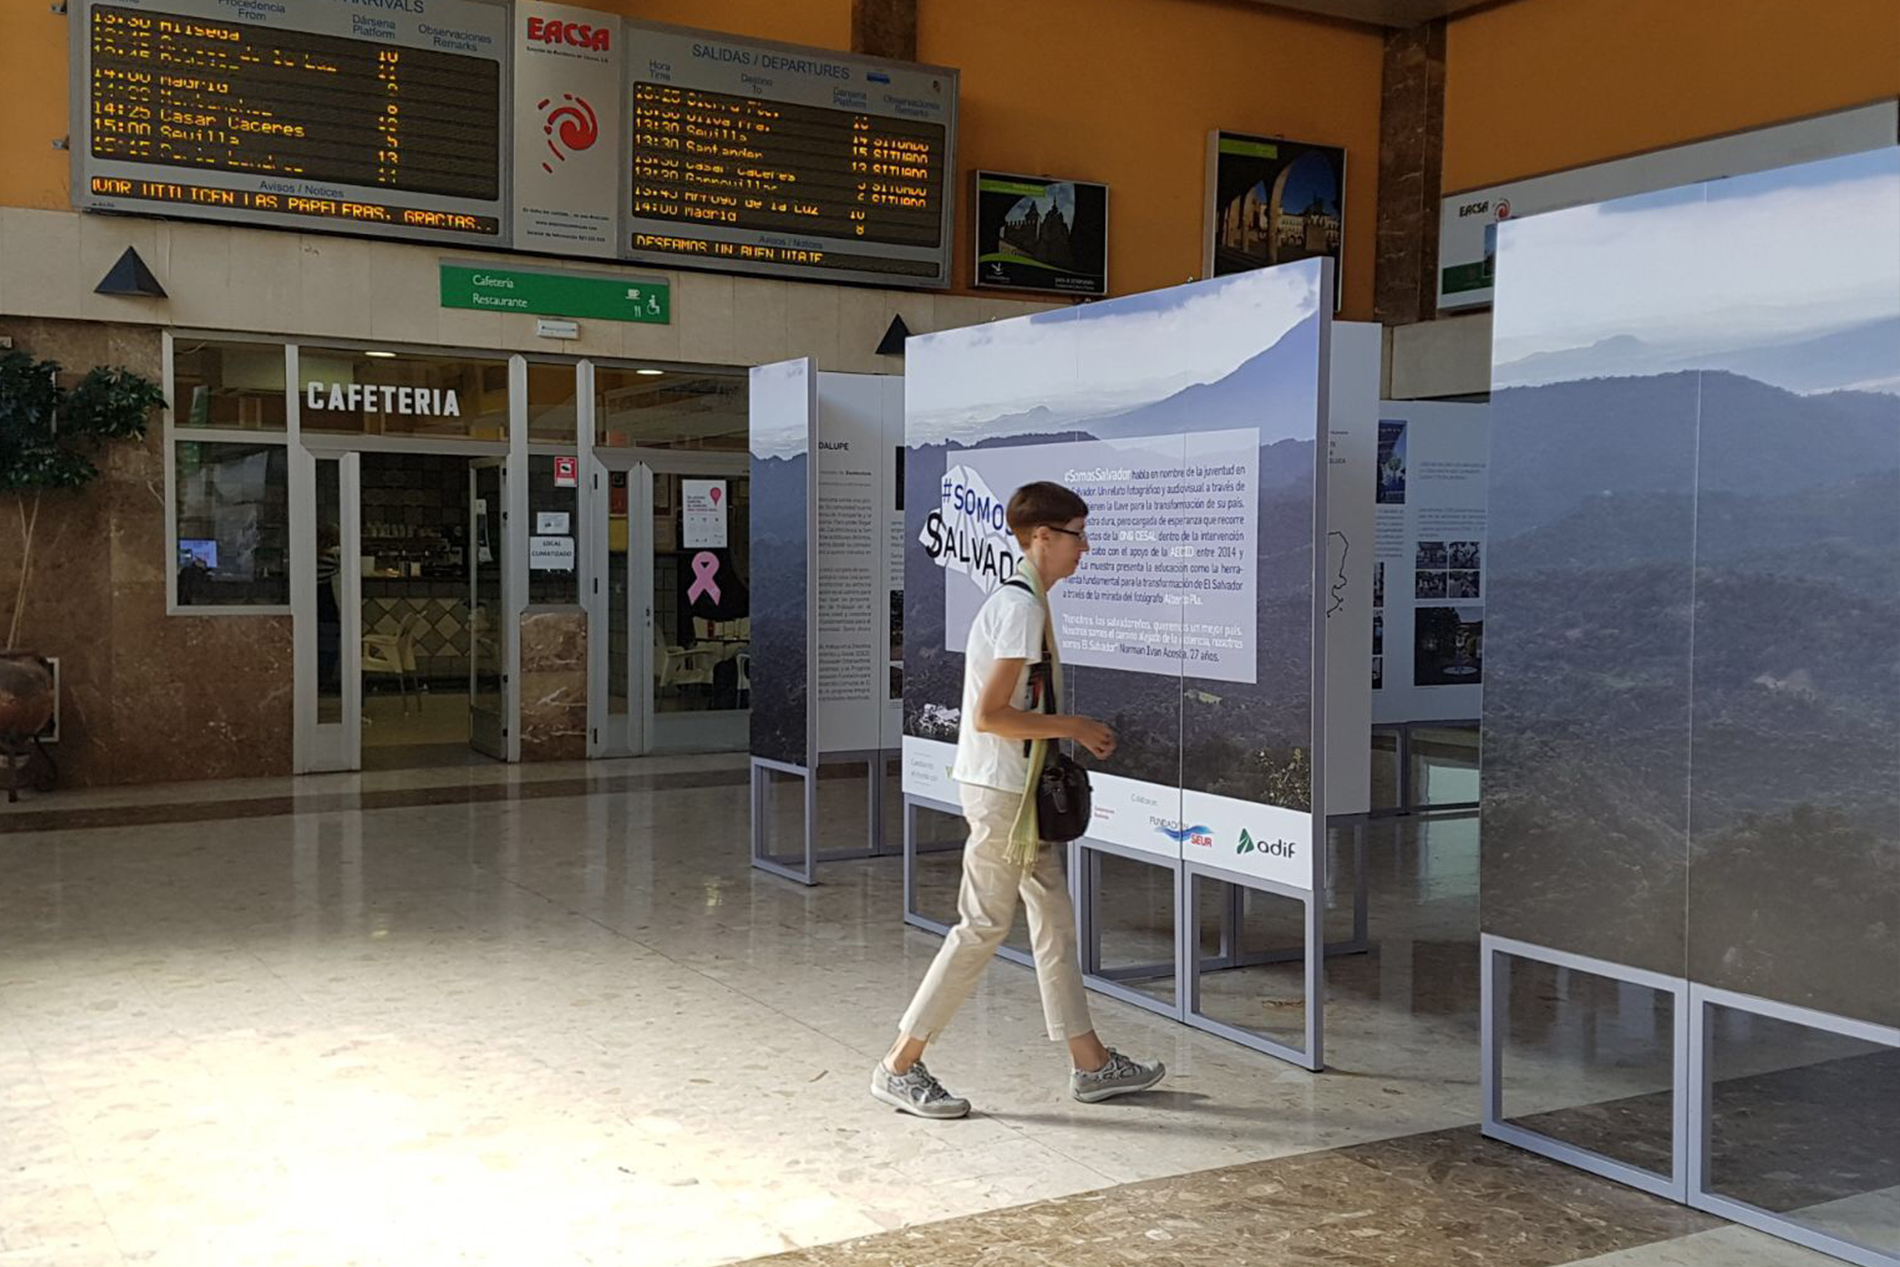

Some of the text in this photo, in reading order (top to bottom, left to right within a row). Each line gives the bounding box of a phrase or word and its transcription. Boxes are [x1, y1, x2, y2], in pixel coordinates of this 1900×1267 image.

[238, 8, 267, 21] From
[352, 14, 396, 30] Dársena
[352, 24, 396, 39] Platform
[418, 24, 492, 44] Observaciones
[527, 16, 610, 51] EACSA
[433, 37, 478, 51] Remarks
[692, 43, 750, 65] SALIDAS
[762, 54, 850, 80] DEPARTURES
[259, 180, 295, 194] Avisos
[304, 184, 345, 198] Notices
[1459, 200, 1489, 217] EACSA
[472, 274, 514, 289] Cafetería
[472, 292, 528, 309] Restaurante
[307, 380, 461, 417] CAFETERIA
[1160, 468, 1184, 478] nombre
[1186, 467, 1195, 477] de
[1196, 466, 1203, 477] la
[1203, 465, 1235, 479] juventud
[1236, 466, 1245, 475] en
[1161, 486, 1166, 497] y
[1167, 482, 1205, 494] audiovisual
[1206, 483, 1210, 492] a
[1212, 480, 1234, 492] través
[1235, 480, 1245, 491] de
[942, 478, 1014, 536] #SOMO
[1107, 496, 1244, 513] la llave para la transformación de su país.
[1159, 516, 1166, 526] de
[1167, 517, 1202, 528] esperanza
[1203, 517, 1217, 527] que
[1218, 516, 1244, 525] recorre
[1103, 530, 1110, 541] de
[1112, 530, 1118, 541] la
[1158, 530, 1180, 541] dentro
[1181, 530, 1190, 541] de
[1192, 530, 1199, 541] la
[1200, 529, 1244, 541] intervención
[926, 512, 1024, 584] SALVAD
[1091, 547, 1105, 556] cabo
[1121, 546, 1128, 556] el
[1130, 547, 1149, 559] apoyo
[1150, 546, 1159, 556] de
[1161, 546, 1168, 557] la
[1196, 547, 1215, 557] entre
[1217, 546, 1236, 558] 2014
[1238, 549, 1245, 560] y
[1090, 561, 1115, 572] muestra
[1116, 562, 1144, 573] presenta
[1146, 562, 1152, 572] la
[1154, 561, 1188, 573] educación
[1189, 564, 1210, 573] como
[1212, 562, 1219, 573] la
[1083, 575, 1244, 591] fundamental para la transformación de El Salvador
[1086, 589, 1093, 600] de
[1094, 590, 1100, 600] la
[1133, 590, 1164, 605] fotógrafo
[1119, 643, 1146, 655] Norman
[1189, 648, 1200, 660] 27
[1191, 834, 1213, 848] SEUR
[1257, 838, 1297, 858] adif
